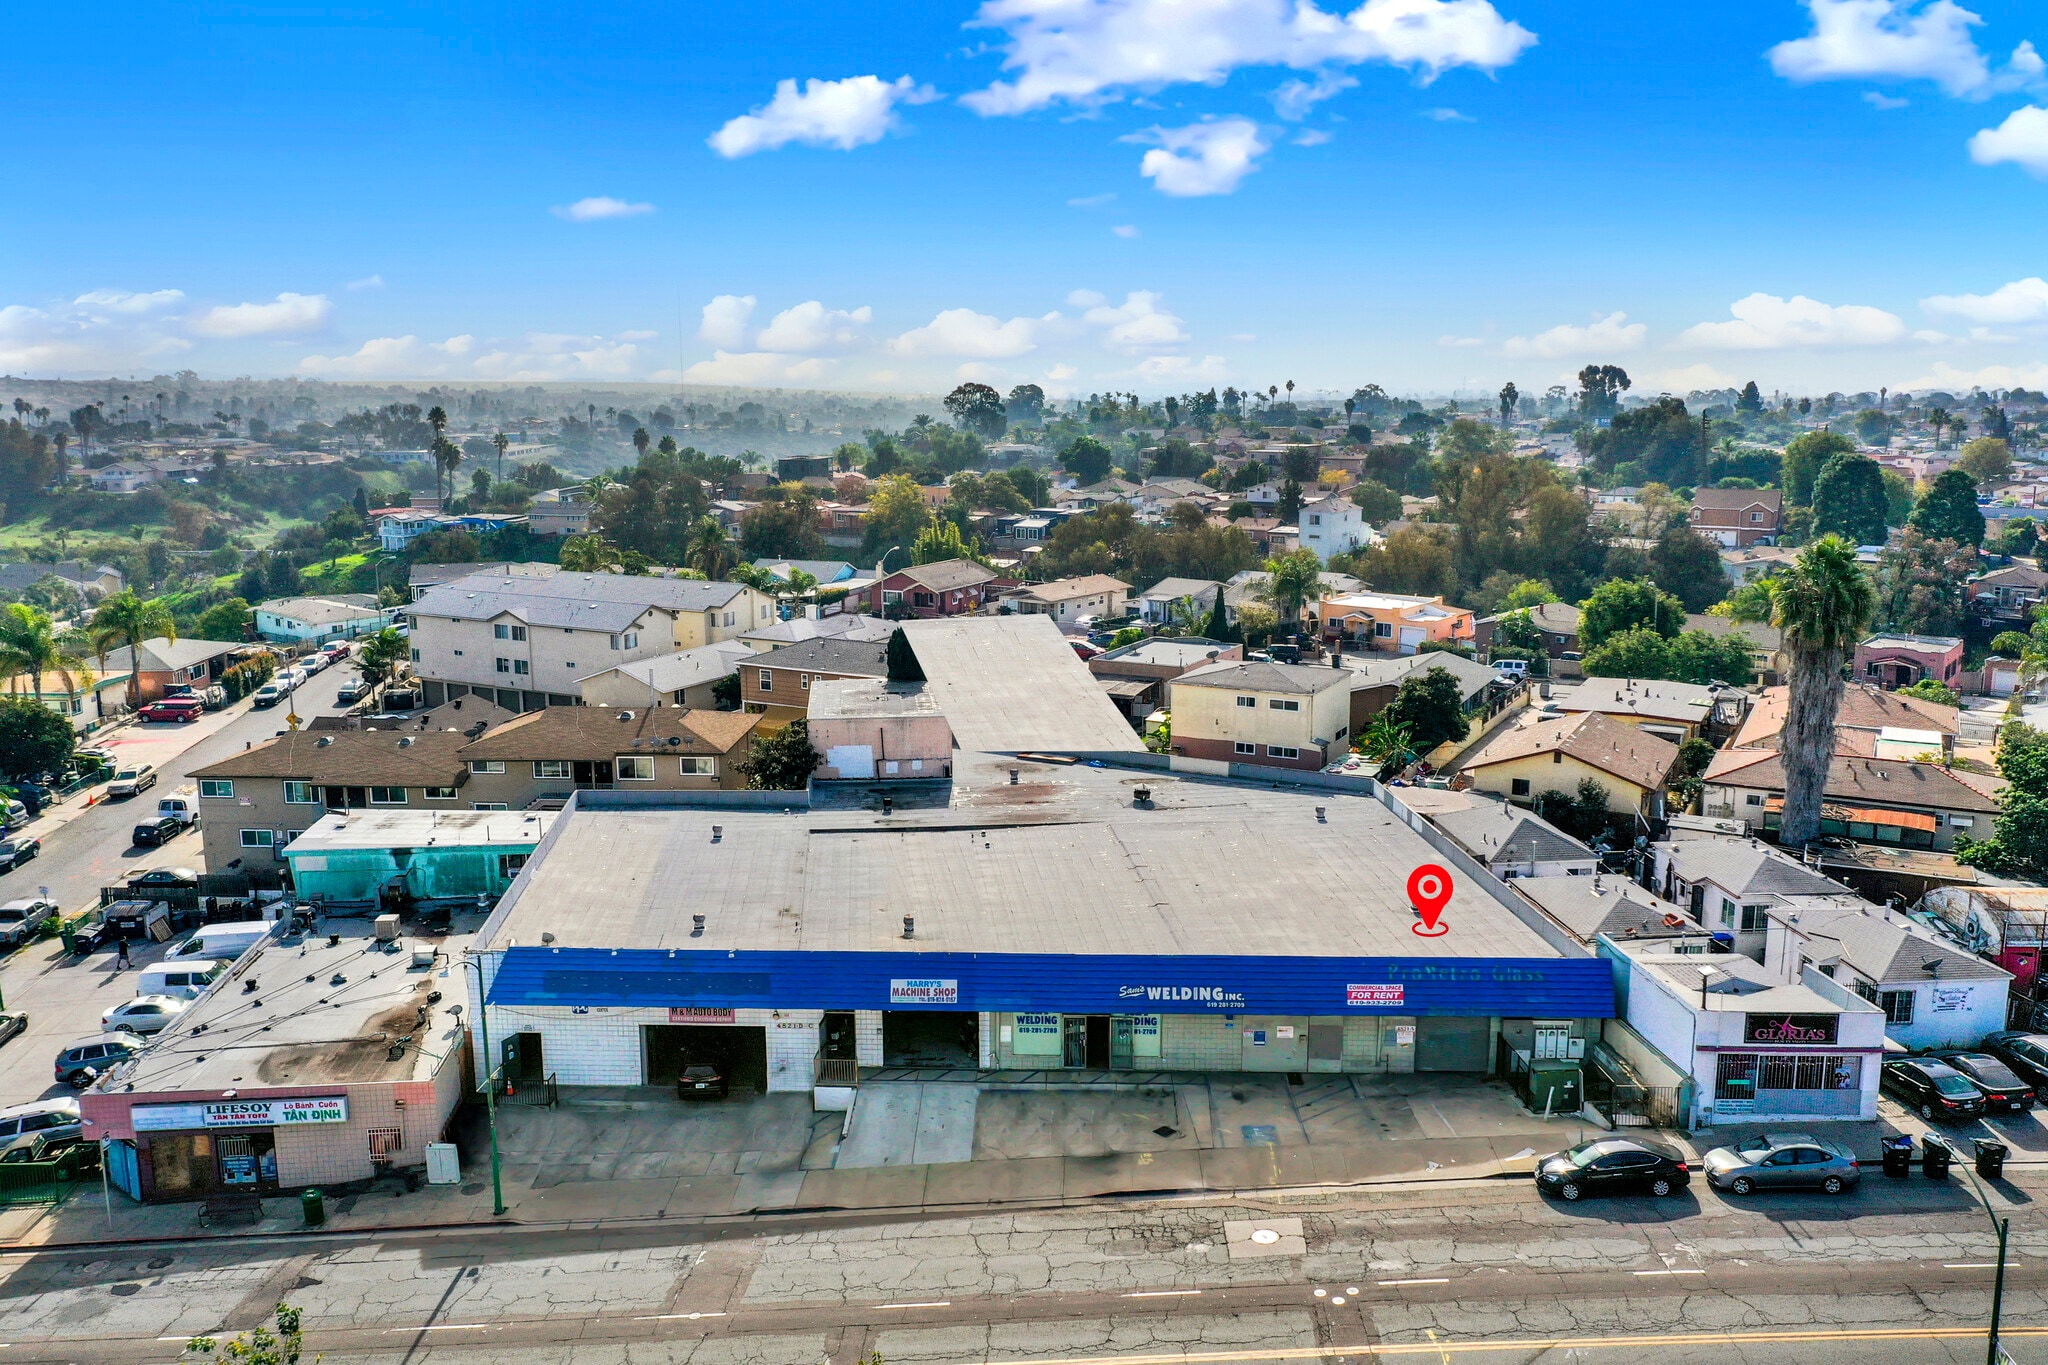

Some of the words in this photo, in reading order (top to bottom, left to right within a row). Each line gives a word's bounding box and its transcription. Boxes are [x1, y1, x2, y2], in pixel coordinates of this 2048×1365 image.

[892, 988, 931, 996] MACHINE
[933, 988, 956, 996] SHOP
[1119, 985, 1145, 998] Sam's
[1147, 987, 1223, 1001] WELDING
[1225, 993, 1245, 1001] INC.
[671, 1007, 678, 1015] M
[679, 1008, 685, 1016] &
[686, 1007, 692, 1016] M
[694, 1008, 712, 1016] AUTO
[713, 1008, 732, 1016] BODY
[1016, 1016, 1058, 1025] WELDING
[206, 1103, 272, 1114] LIFESOY
[282, 1109, 308, 1121] TÂN
[311, 1109, 342, 1122] ĐỊNH
